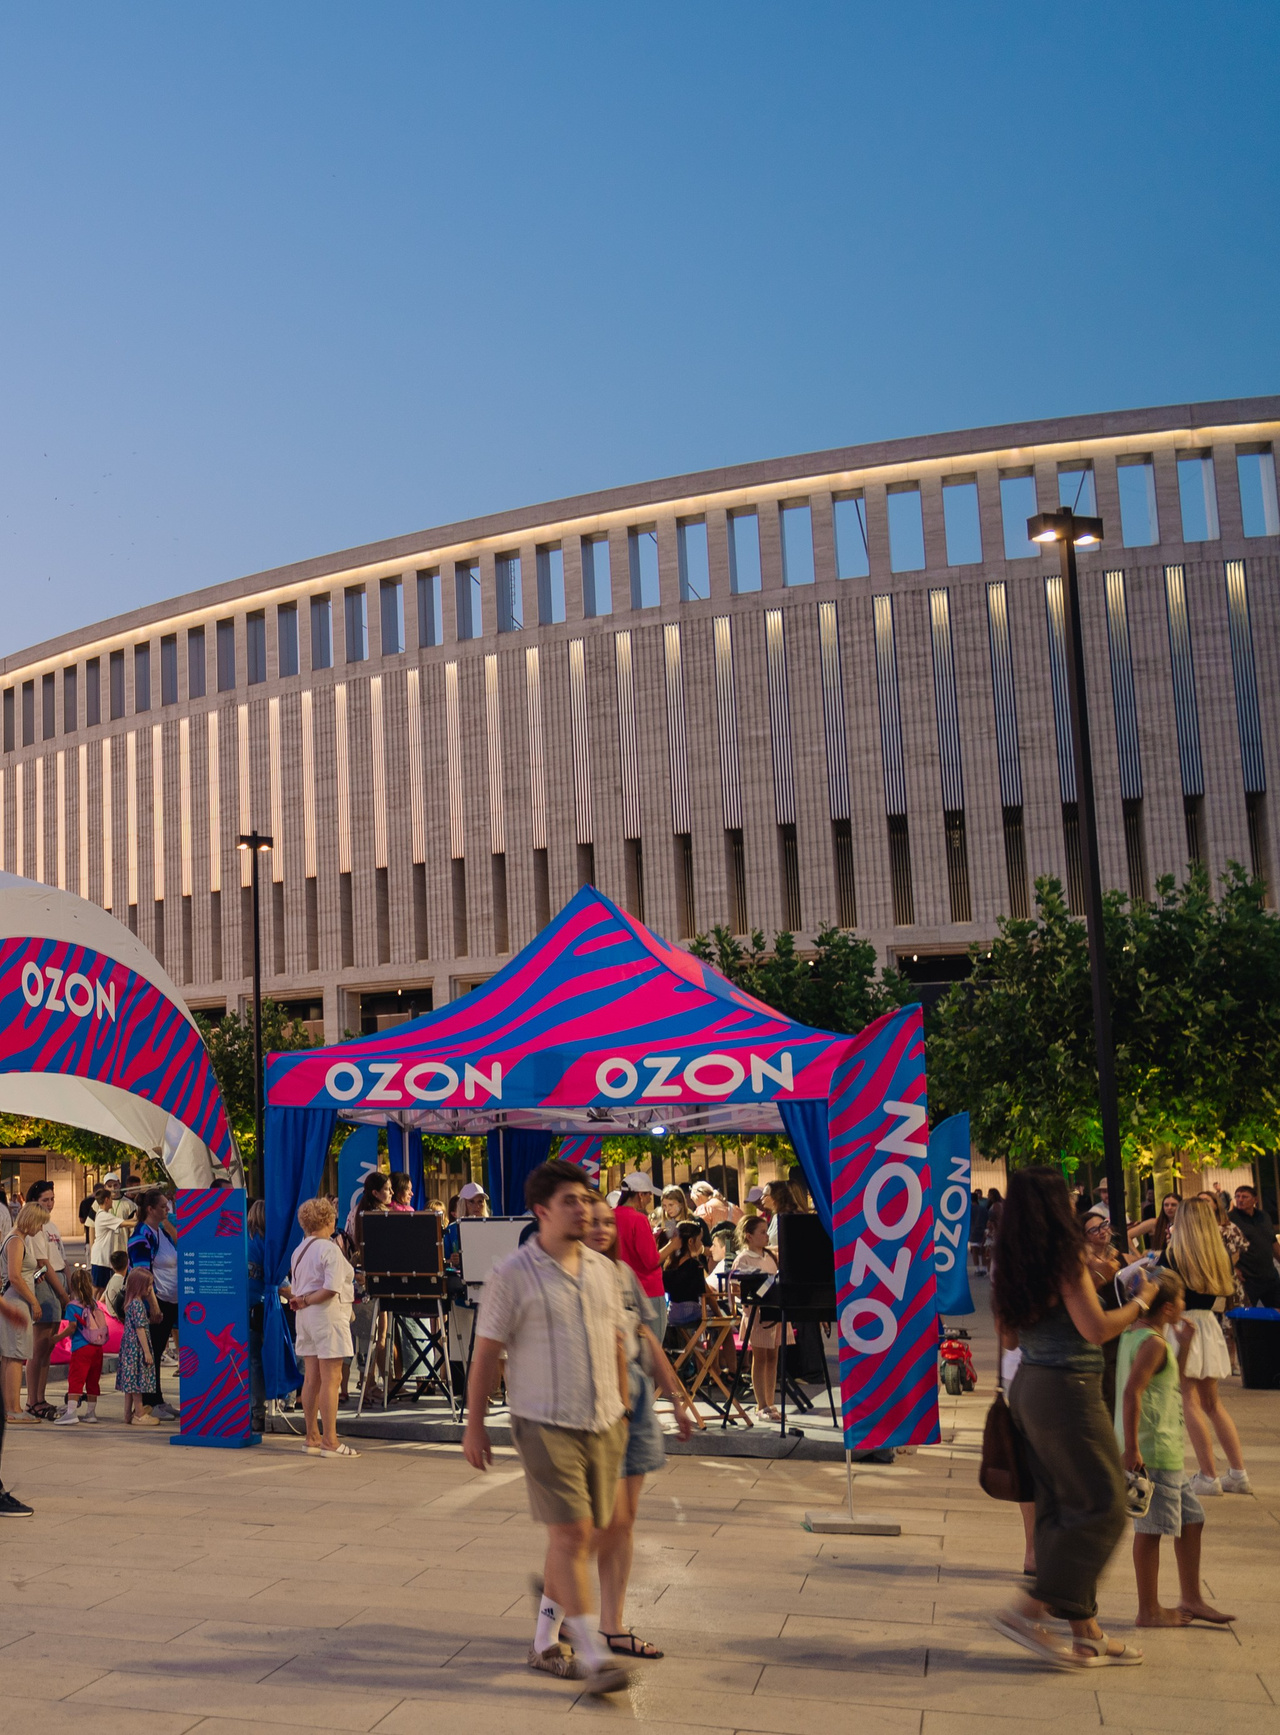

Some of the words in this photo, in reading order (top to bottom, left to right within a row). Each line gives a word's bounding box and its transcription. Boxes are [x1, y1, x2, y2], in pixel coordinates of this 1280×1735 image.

[21, 962, 118, 1023] OZON
[324, 1061, 503, 1101] OZON
[595, 1052, 795, 1098] OZON
[840, 1100, 928, 1355] OZON
[933, 1156, 970, 1272] OZON
